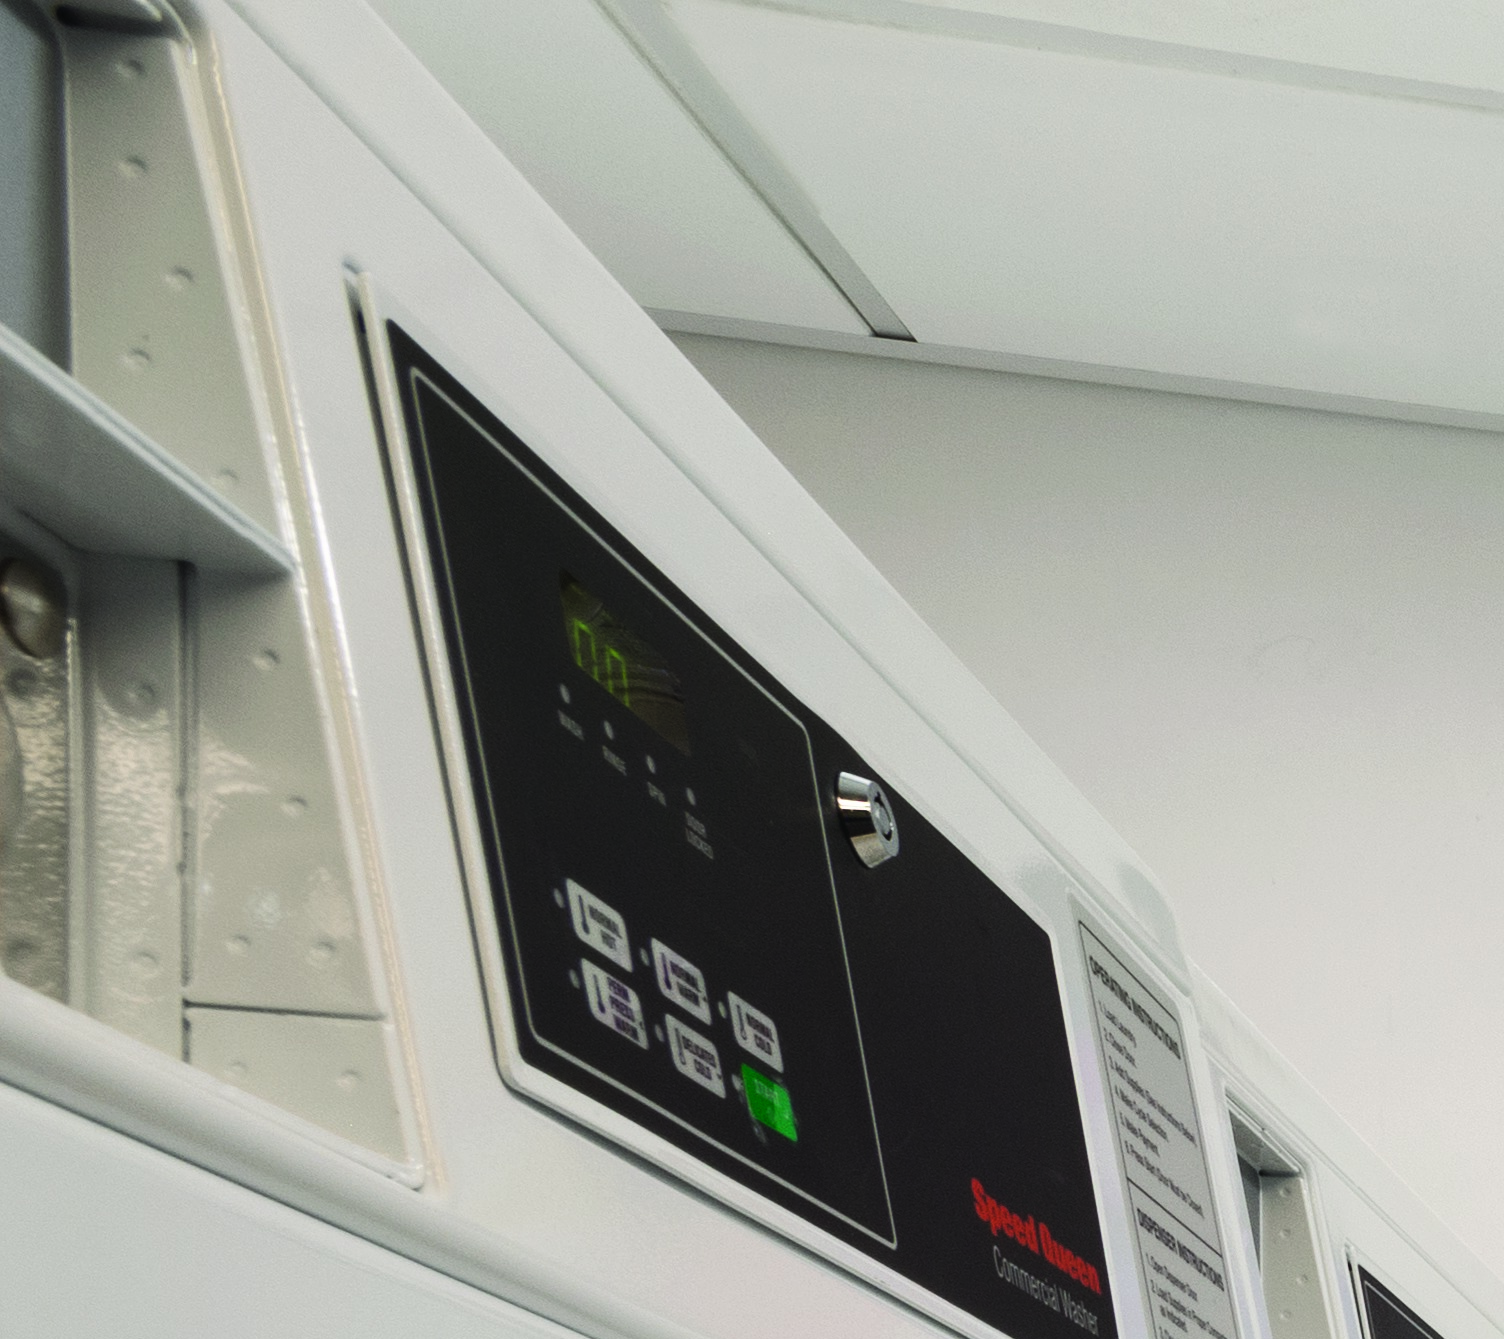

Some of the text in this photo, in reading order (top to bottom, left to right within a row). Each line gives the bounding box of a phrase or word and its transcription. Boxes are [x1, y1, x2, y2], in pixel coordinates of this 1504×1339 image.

[1089, 955, 1181, 1060] OPERATING INSTRUCTIONS
[970, 1177, 1101, 1294] Speed Queen
[1136, 1208, 1224, 1292] DISPENSER INSTRUCTIONS
[992, 1244, 1098, 1335] Commercial Washer
